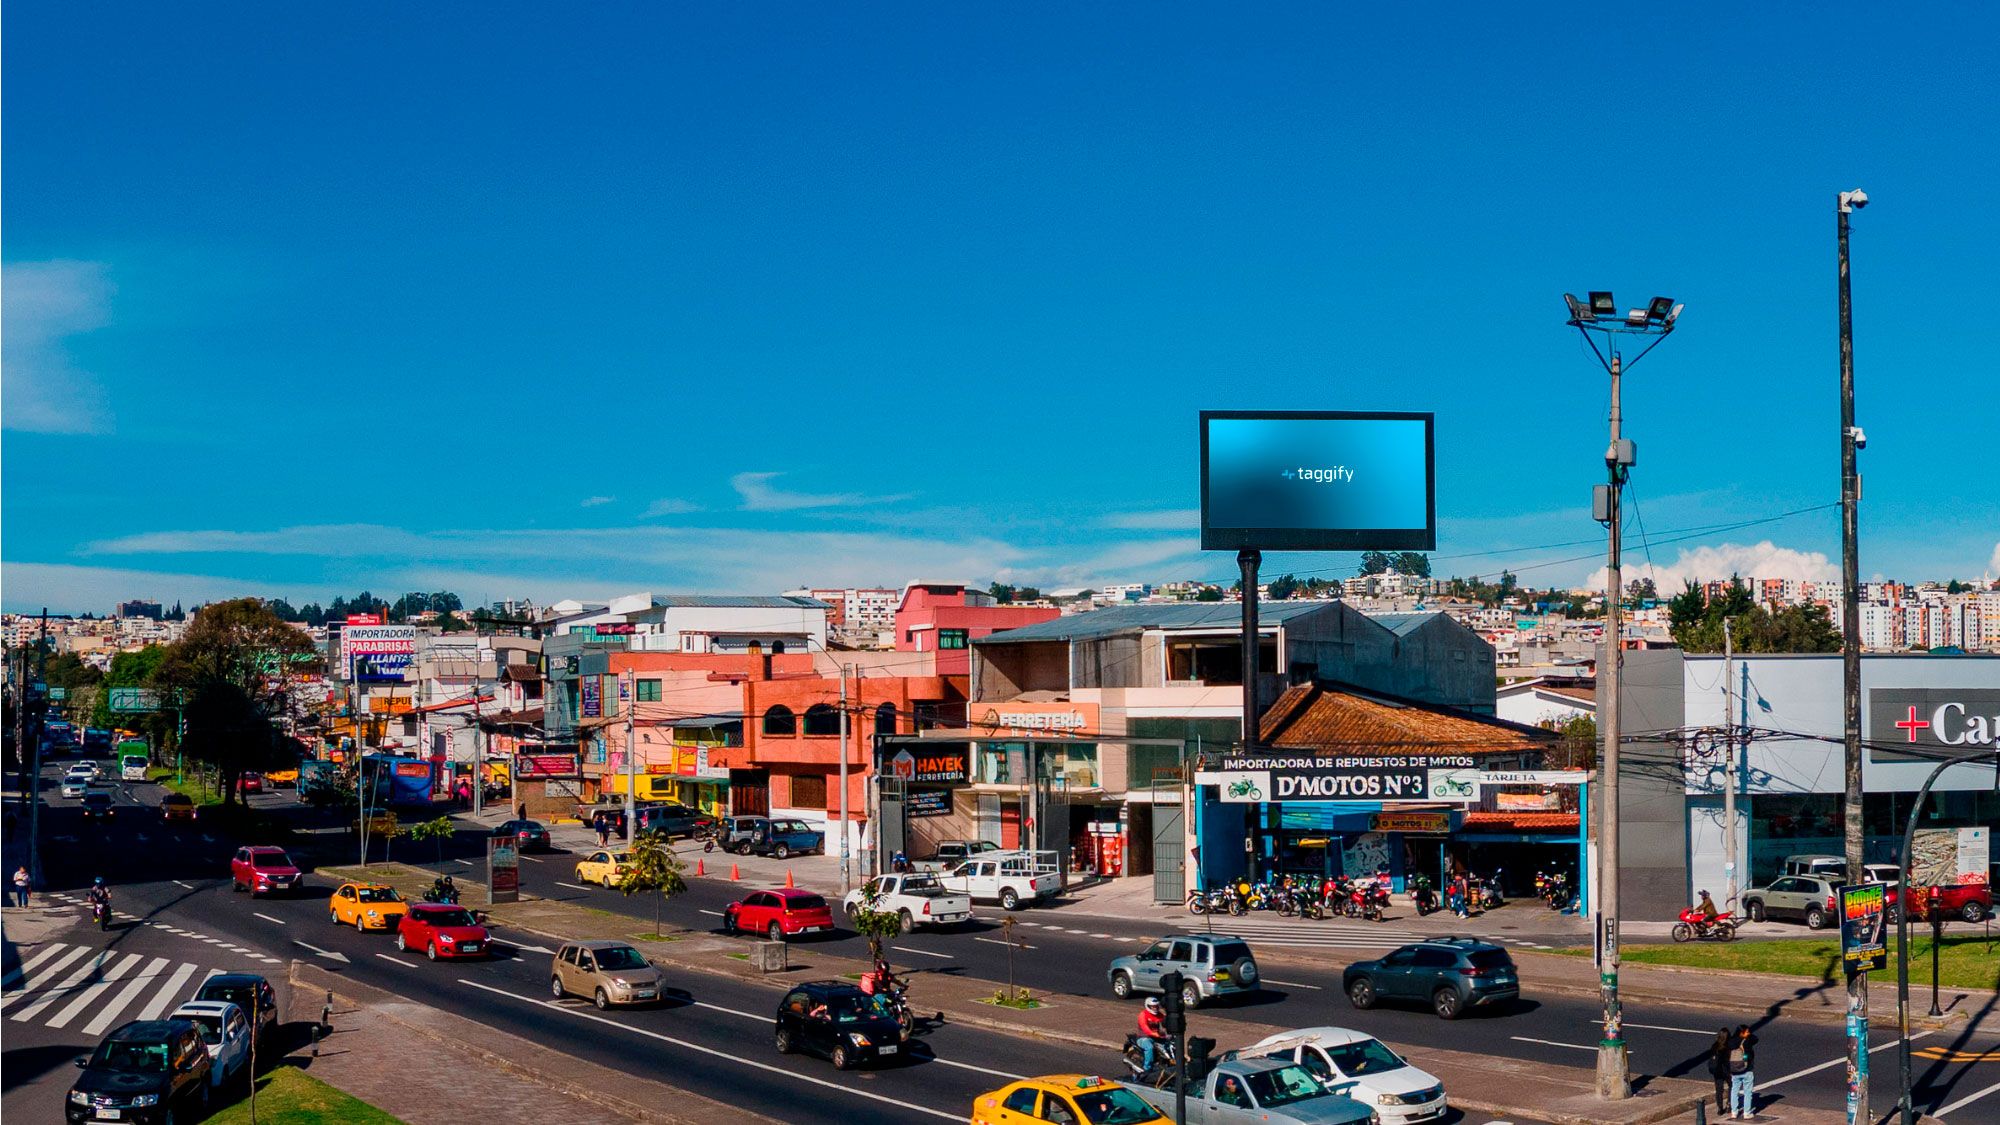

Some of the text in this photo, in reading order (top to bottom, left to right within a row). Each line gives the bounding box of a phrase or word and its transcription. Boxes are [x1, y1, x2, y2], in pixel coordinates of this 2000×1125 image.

[1298, 466, 1354, 482] taggify
[350, 629, 415, 639] IMPORTADORA
[351, 641, 415, 652] PARABRISAS
[1000, 708, 1087, 728] FERRETERÍA
[917, 757, 964, 773] HAYEK
[1224, 756, 1474, 769] IMPORTADORA DE REPUESTOS DE MOTOS
[917, 770, 965, 781] FERRETERÍA
[1277, 775, 1380, 796] D'MOTOS
